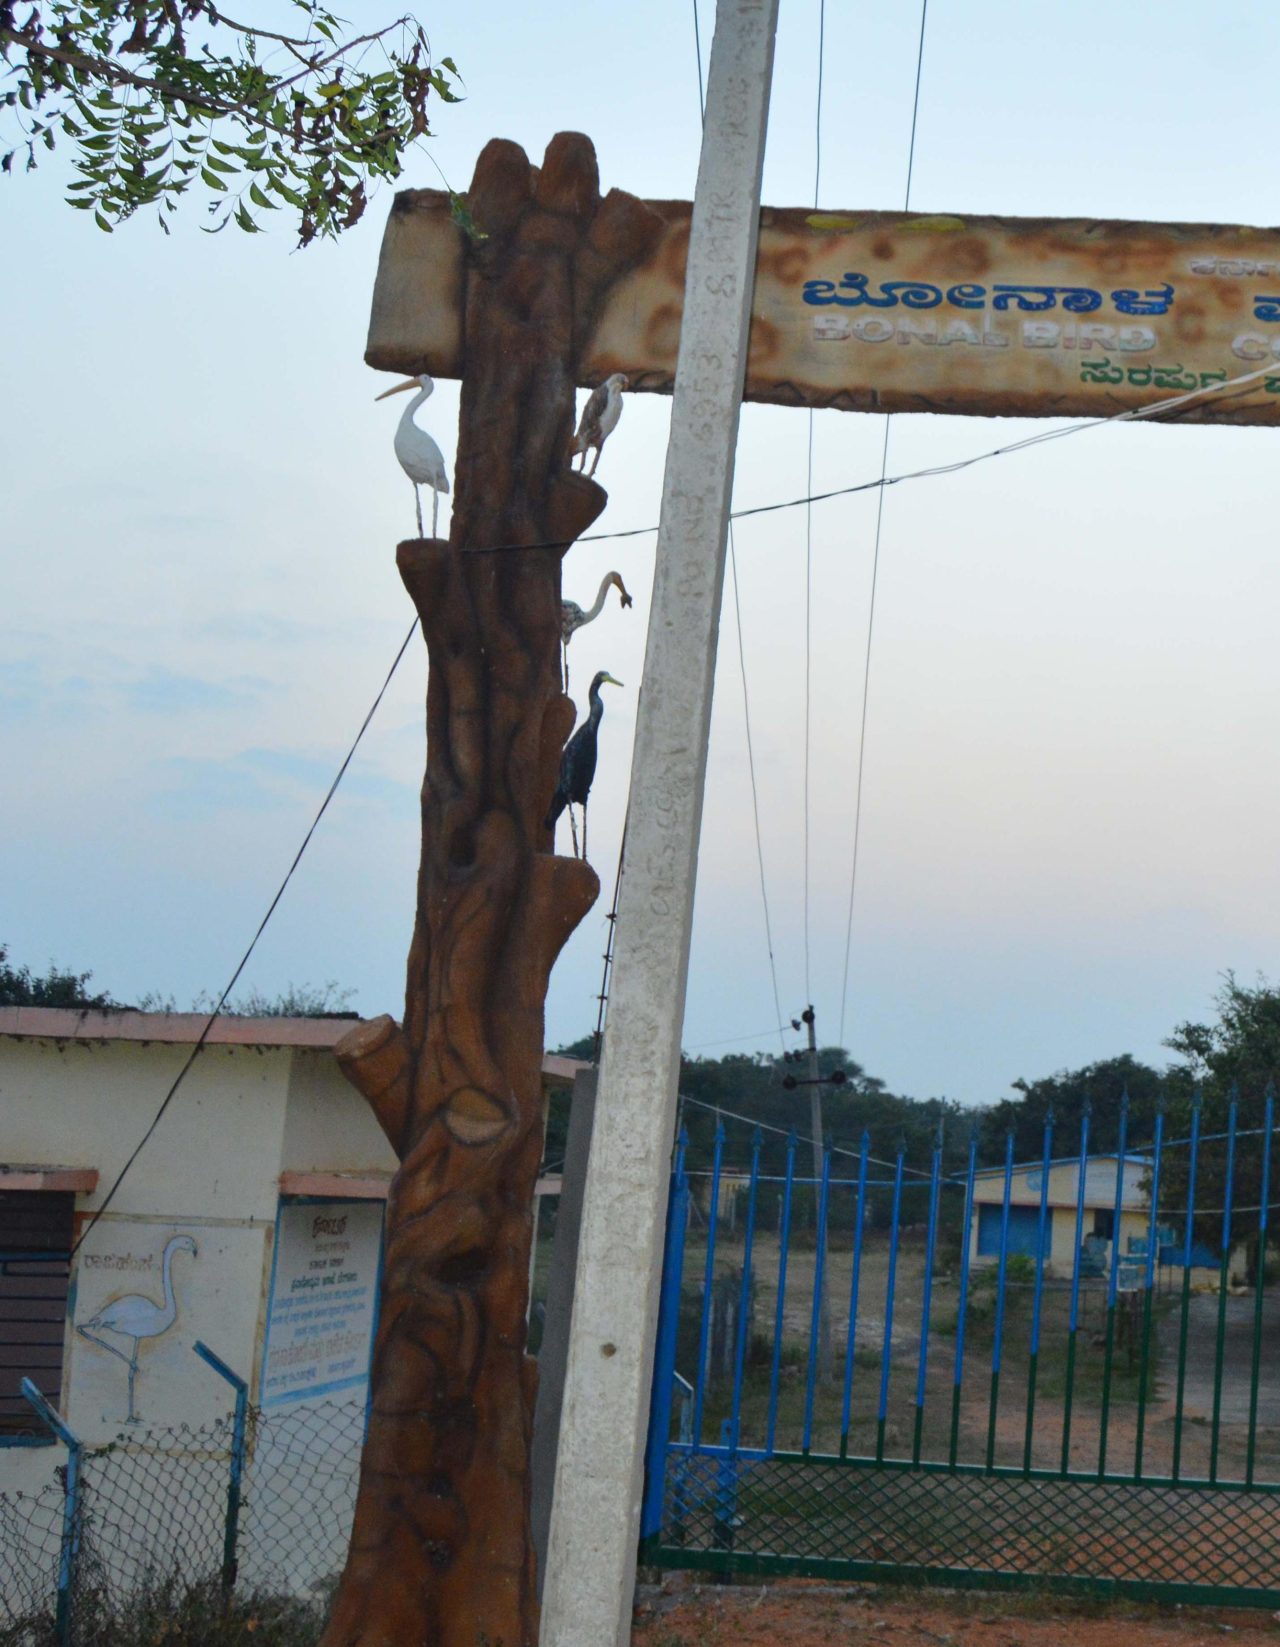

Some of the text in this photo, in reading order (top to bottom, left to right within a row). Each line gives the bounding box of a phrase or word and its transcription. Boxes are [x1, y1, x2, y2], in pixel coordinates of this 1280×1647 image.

[802, 272, 1174, 315] ಬೋನಾಳ
[813, 313, 1009, 348] BONAL
[1022, 320, 1157, 352] BIRD
